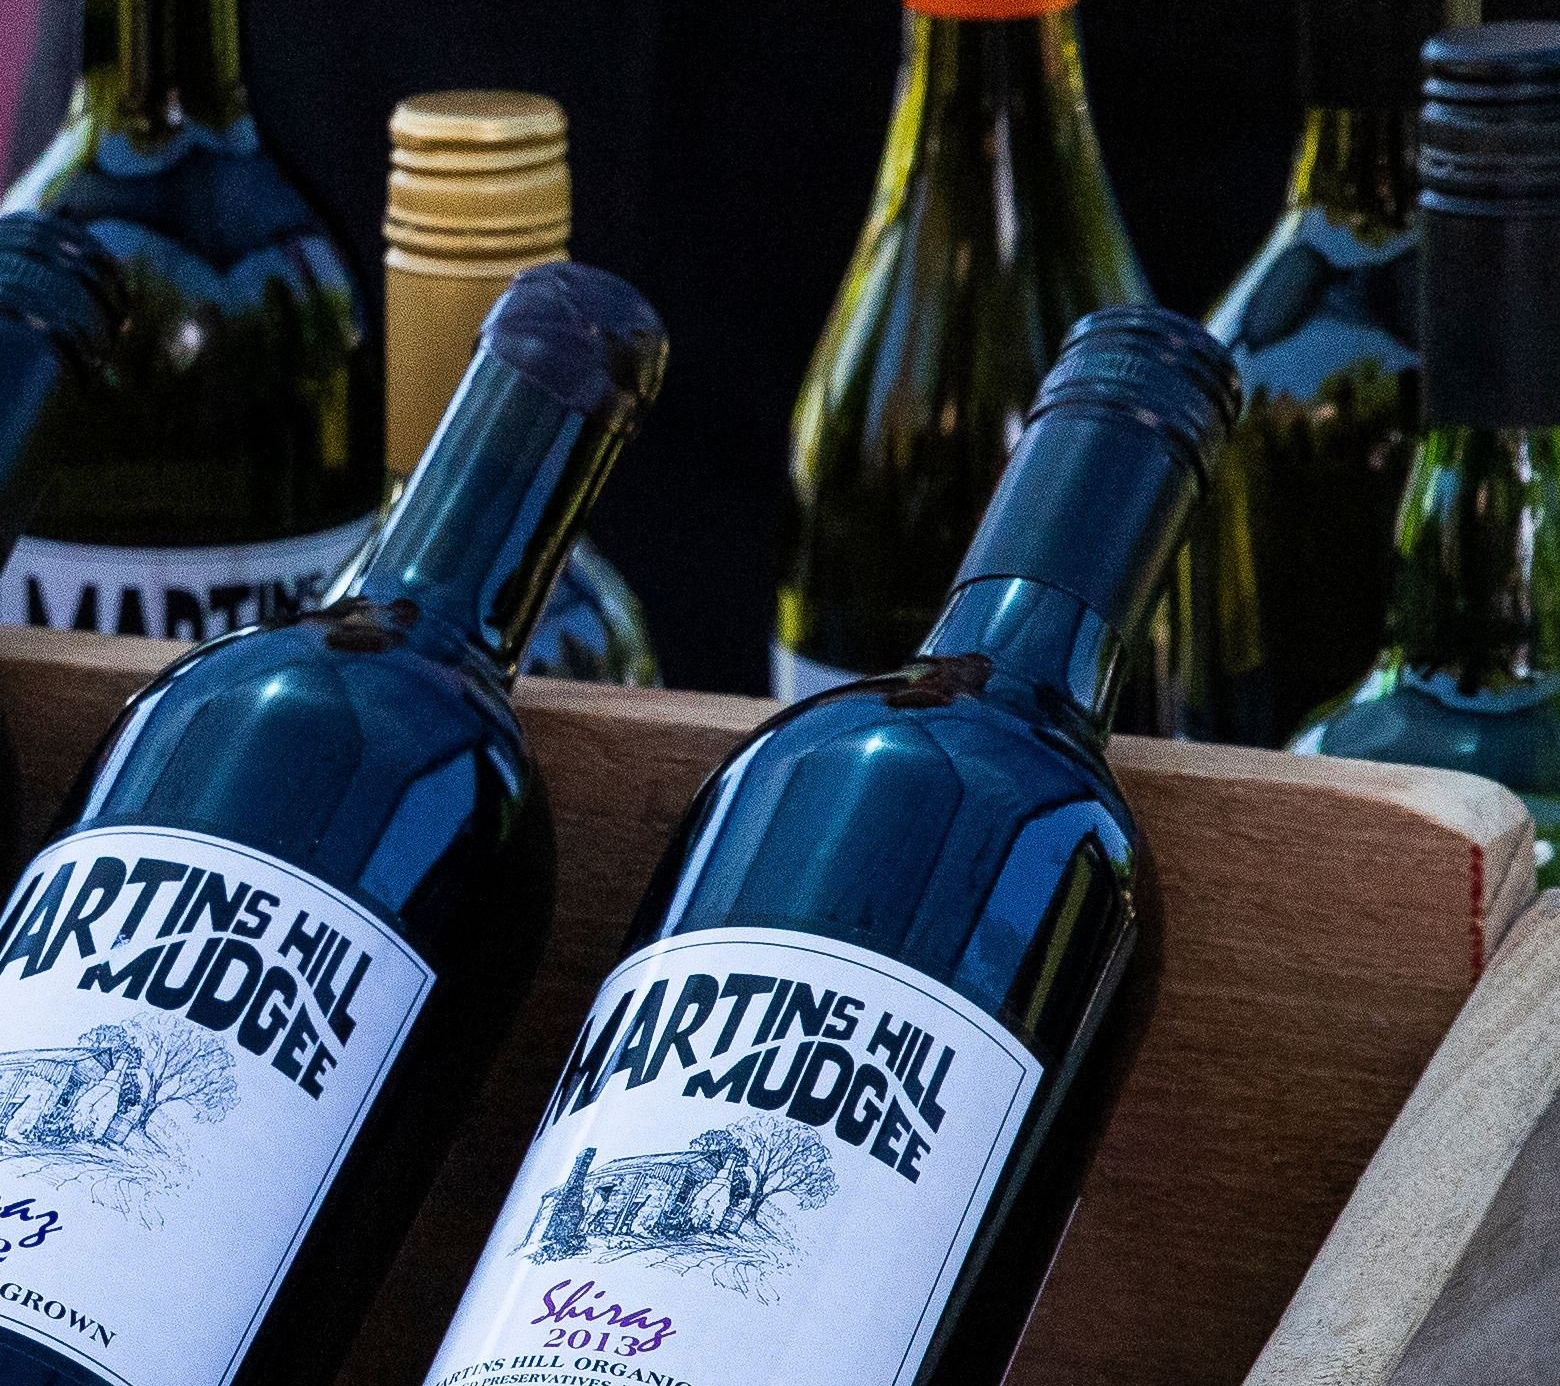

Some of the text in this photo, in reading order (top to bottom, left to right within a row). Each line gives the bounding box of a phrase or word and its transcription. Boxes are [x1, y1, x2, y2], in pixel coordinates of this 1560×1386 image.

[77, 933, 340, 1101] MUDGEE
[278, 912, 373, 1045] HILL
[535, 973, 956, 1142] MARTINS HILL
[682, 1042, 932, 1184] MUDGEE
[510, 1354, 566, 1369] HILL
[530, 1278, 677, 1353] Shiraz
[542, 1326, 642, 1359] 2013
